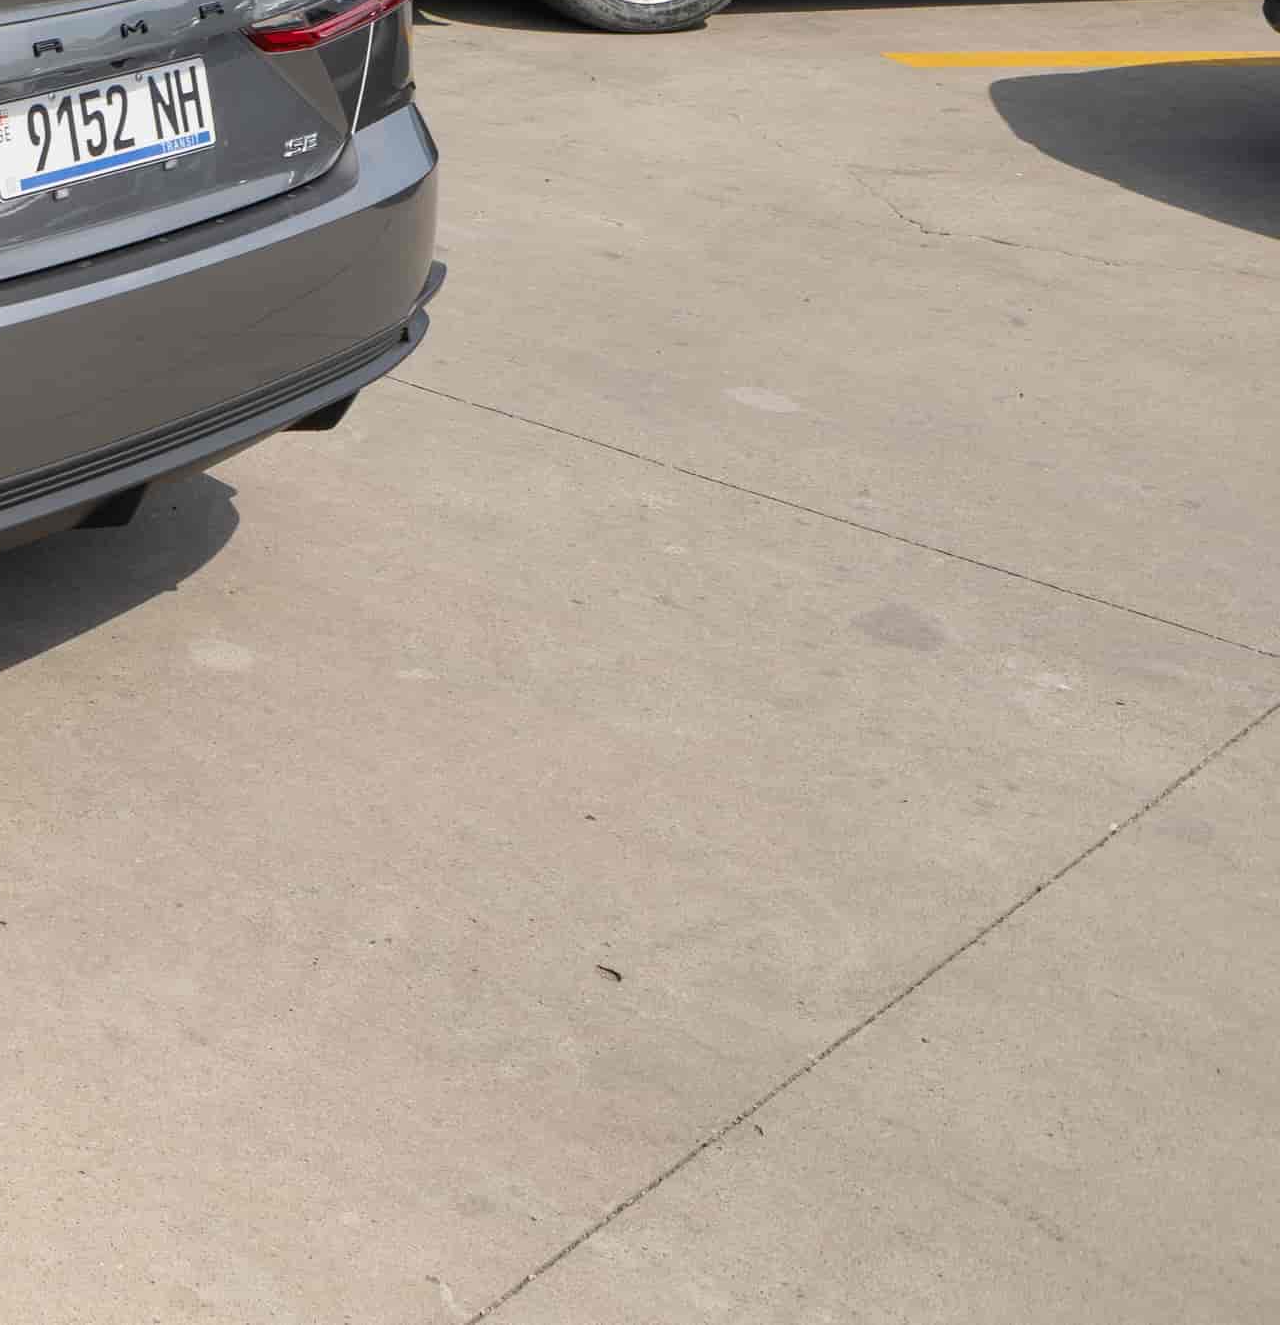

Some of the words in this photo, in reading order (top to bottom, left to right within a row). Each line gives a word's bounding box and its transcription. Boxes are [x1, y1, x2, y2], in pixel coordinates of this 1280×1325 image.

[27, 83, 135, 172] 9152
[148, 65, 205, 140] NH
[160, 132, 200, 154] TRANSIT
[283, 132, 318, 157] SE
